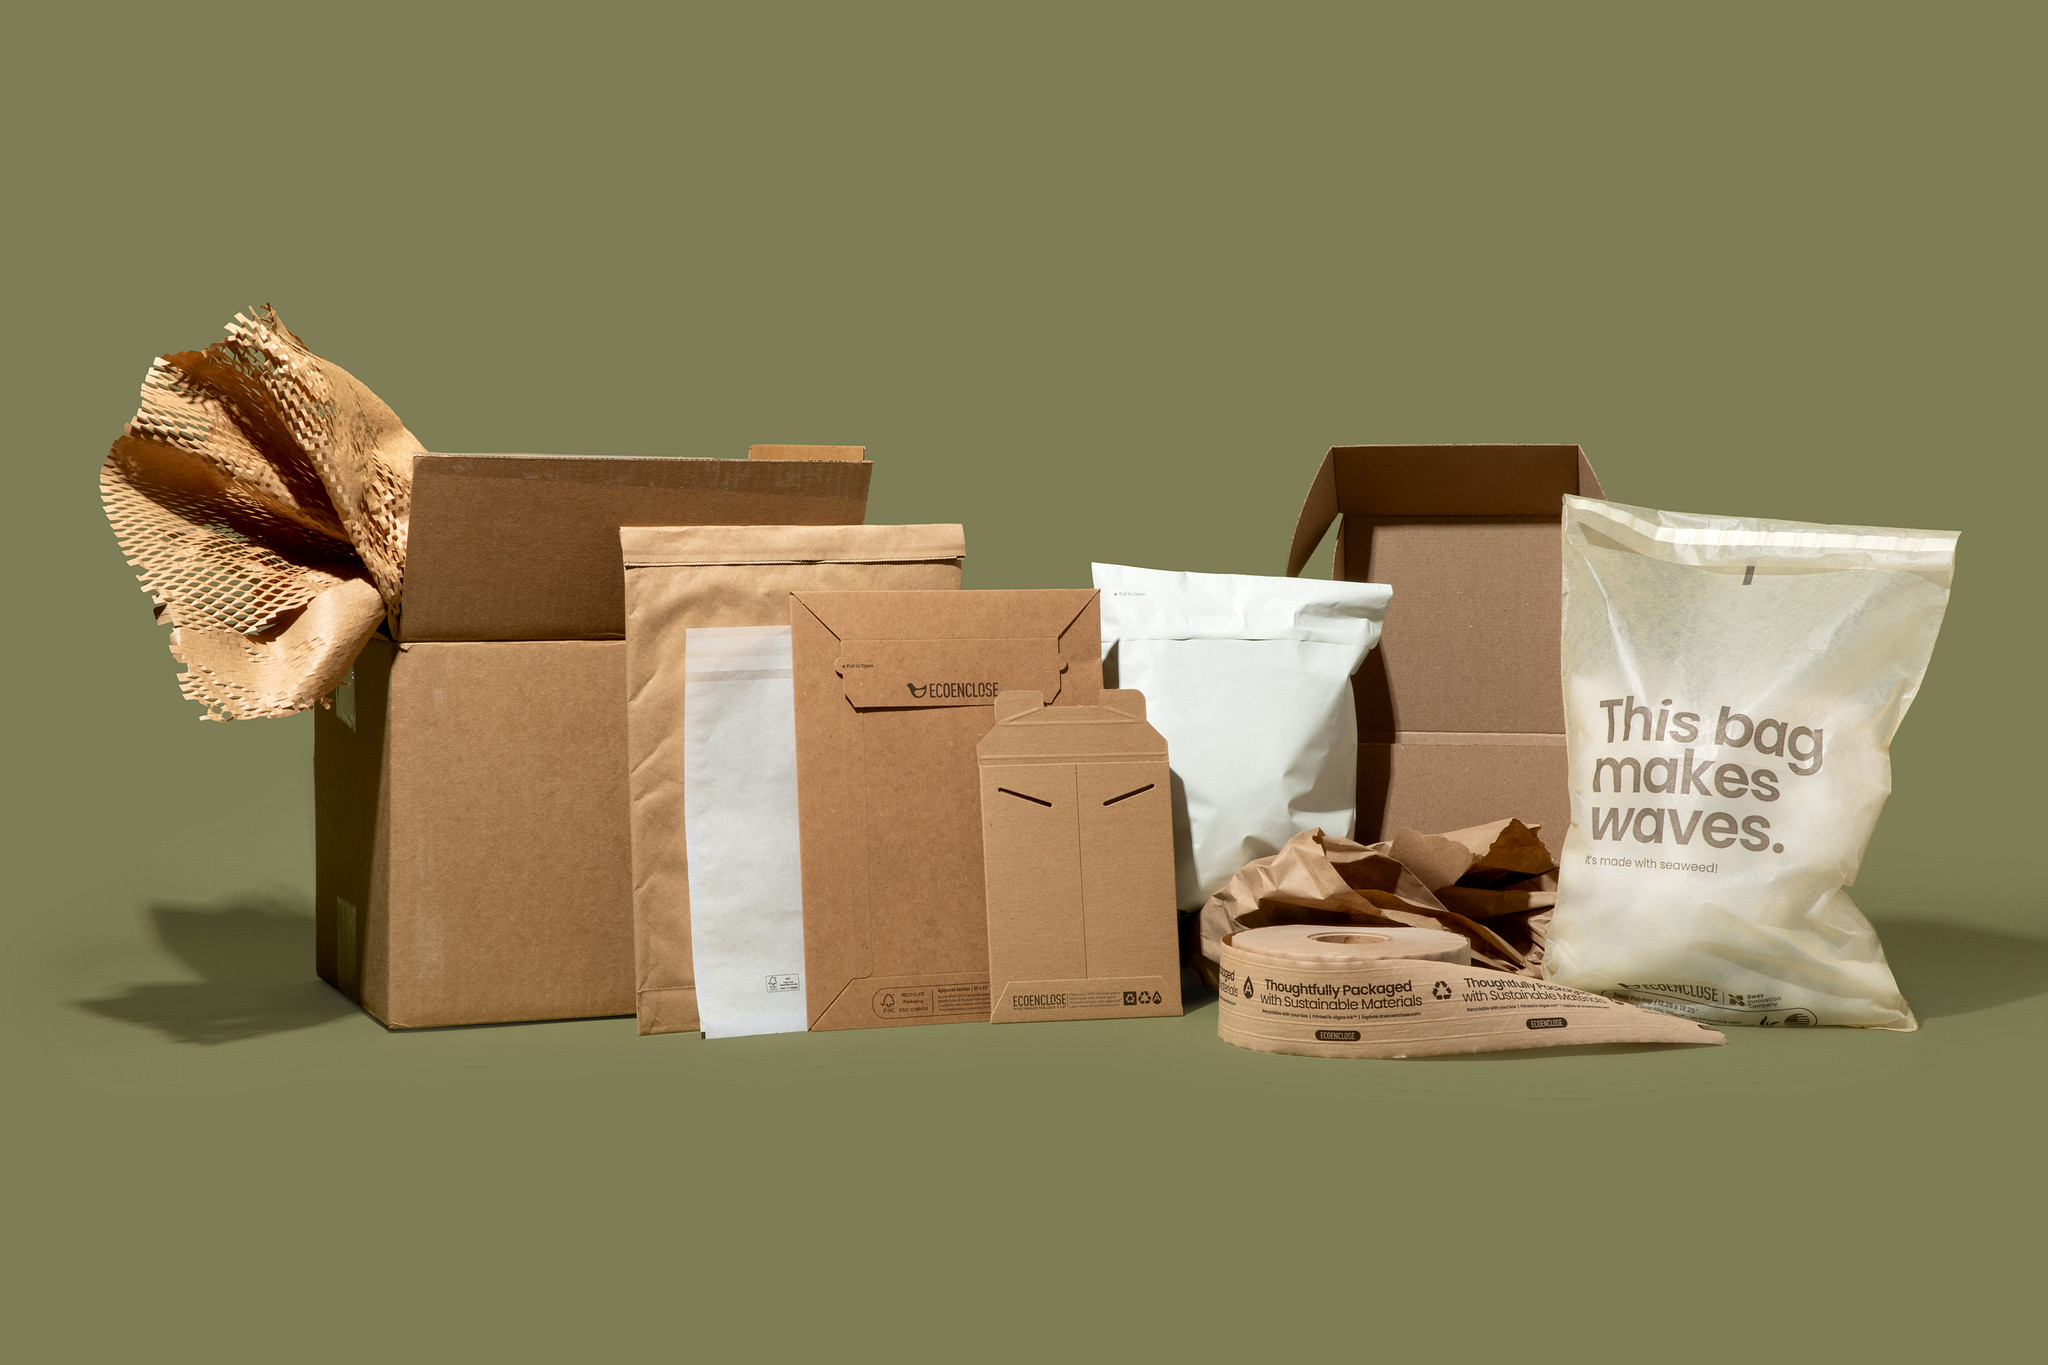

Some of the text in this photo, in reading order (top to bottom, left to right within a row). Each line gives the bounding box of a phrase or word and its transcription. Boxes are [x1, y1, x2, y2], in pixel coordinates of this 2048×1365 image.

[929, 682, 999, 698] ECOENCLOSE
[1600, 695, 1824, 776] This bag
[1592, 748, 1780, 802] makes
[1591, 806, 1785, 854] waves.
[1600, 856, 1632, 868] made
[1634, 857, 1657, 869] with
[1660, 861, 1718, 874] seaweed!
[1264, 978, 1412, 999] Thoughtfully Packaged
[1464, 977, 1536, 992] Thoughtfully
[1013, 993, 1067, 1007] ECOENCLOSE
[1462, 990, 1489, 1003] with
[1490, 990, 1556, 1002] Sustainable
[1640, 983, 1719, 1002] ECOENCLOSE
[1747, 996, 1782, 1004] Innovation
[1260, 993, 1423, 1011] with Sustainable Materials
[1657, 999, 1674, 1009] 12.25
[1748, 1001, 1779, 1009] Company
[1384, 1011, 1421, 1019] ecoenclose.com
[1530, 1018, 1564, 1028] ECOENCLOSE
[1320, 1031, 1356, 1040] ECOENCLOSE
